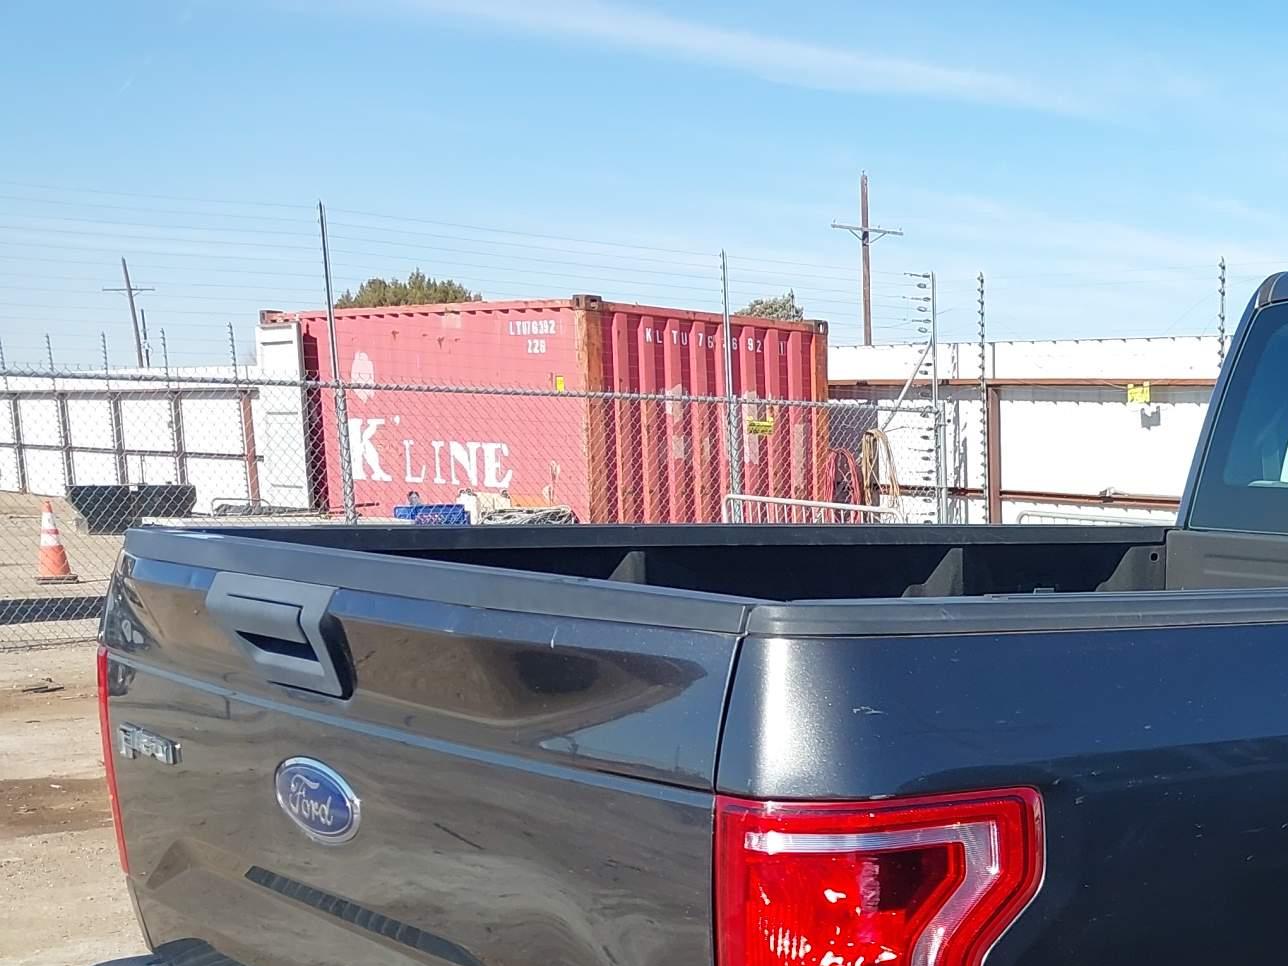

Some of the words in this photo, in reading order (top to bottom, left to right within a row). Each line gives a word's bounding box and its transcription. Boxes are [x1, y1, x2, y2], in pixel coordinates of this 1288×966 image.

[645, 328, 688, 346] KLTU
[698, 332, 762, 353] 76692
[403, 439, 513, 489] LINE
[289, 773, 334, 826] Ford
